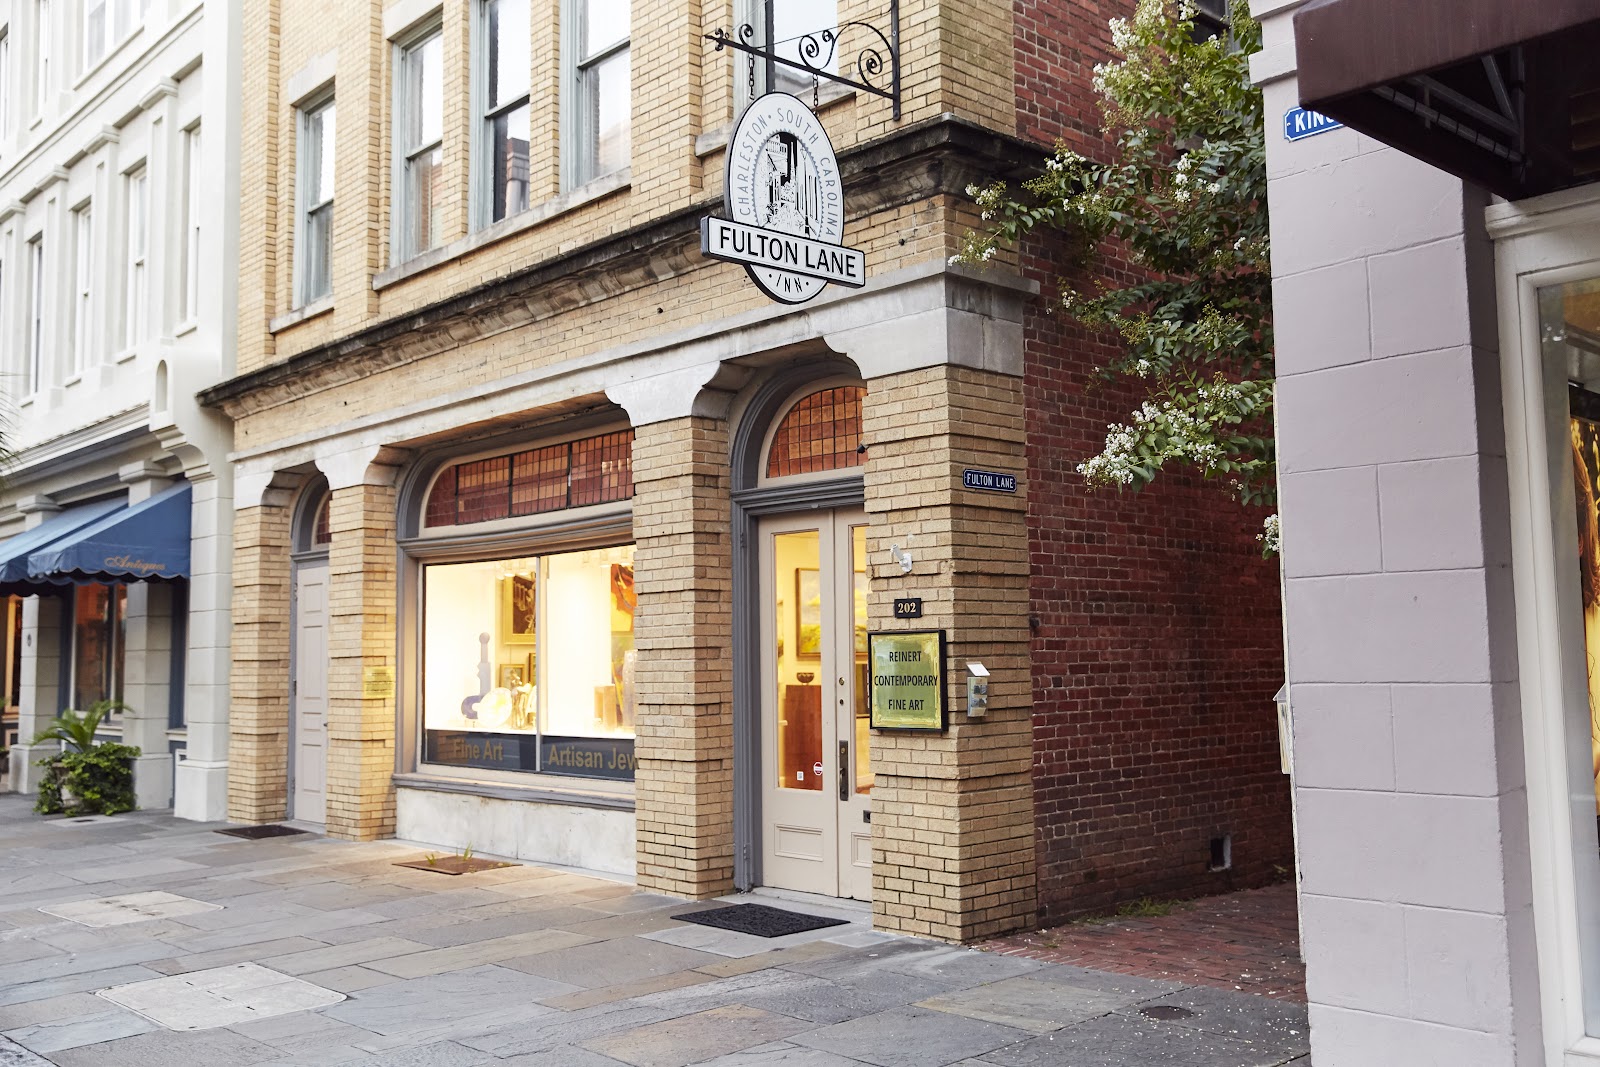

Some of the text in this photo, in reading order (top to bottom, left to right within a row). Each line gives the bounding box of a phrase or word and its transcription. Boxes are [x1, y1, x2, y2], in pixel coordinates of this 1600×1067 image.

[737, 108, 838, 237] CHARLESTON SOUTH CAROLINA
[720, 226, 857, 278] FULTON LANE
[776, 273, 803, 293] INN
[966, 473, 1014, 489] FULTON LANE
[898, 602, 917, 614] 202
[889, 651, 922, 662] REINERT
[874, 675, 939, 687] CONTEMPORARY
[888, 699, 925, 710] FINE ART
[454, 738, 504, 760] Fine Art
[548, 744, 603, 769] Artisan
